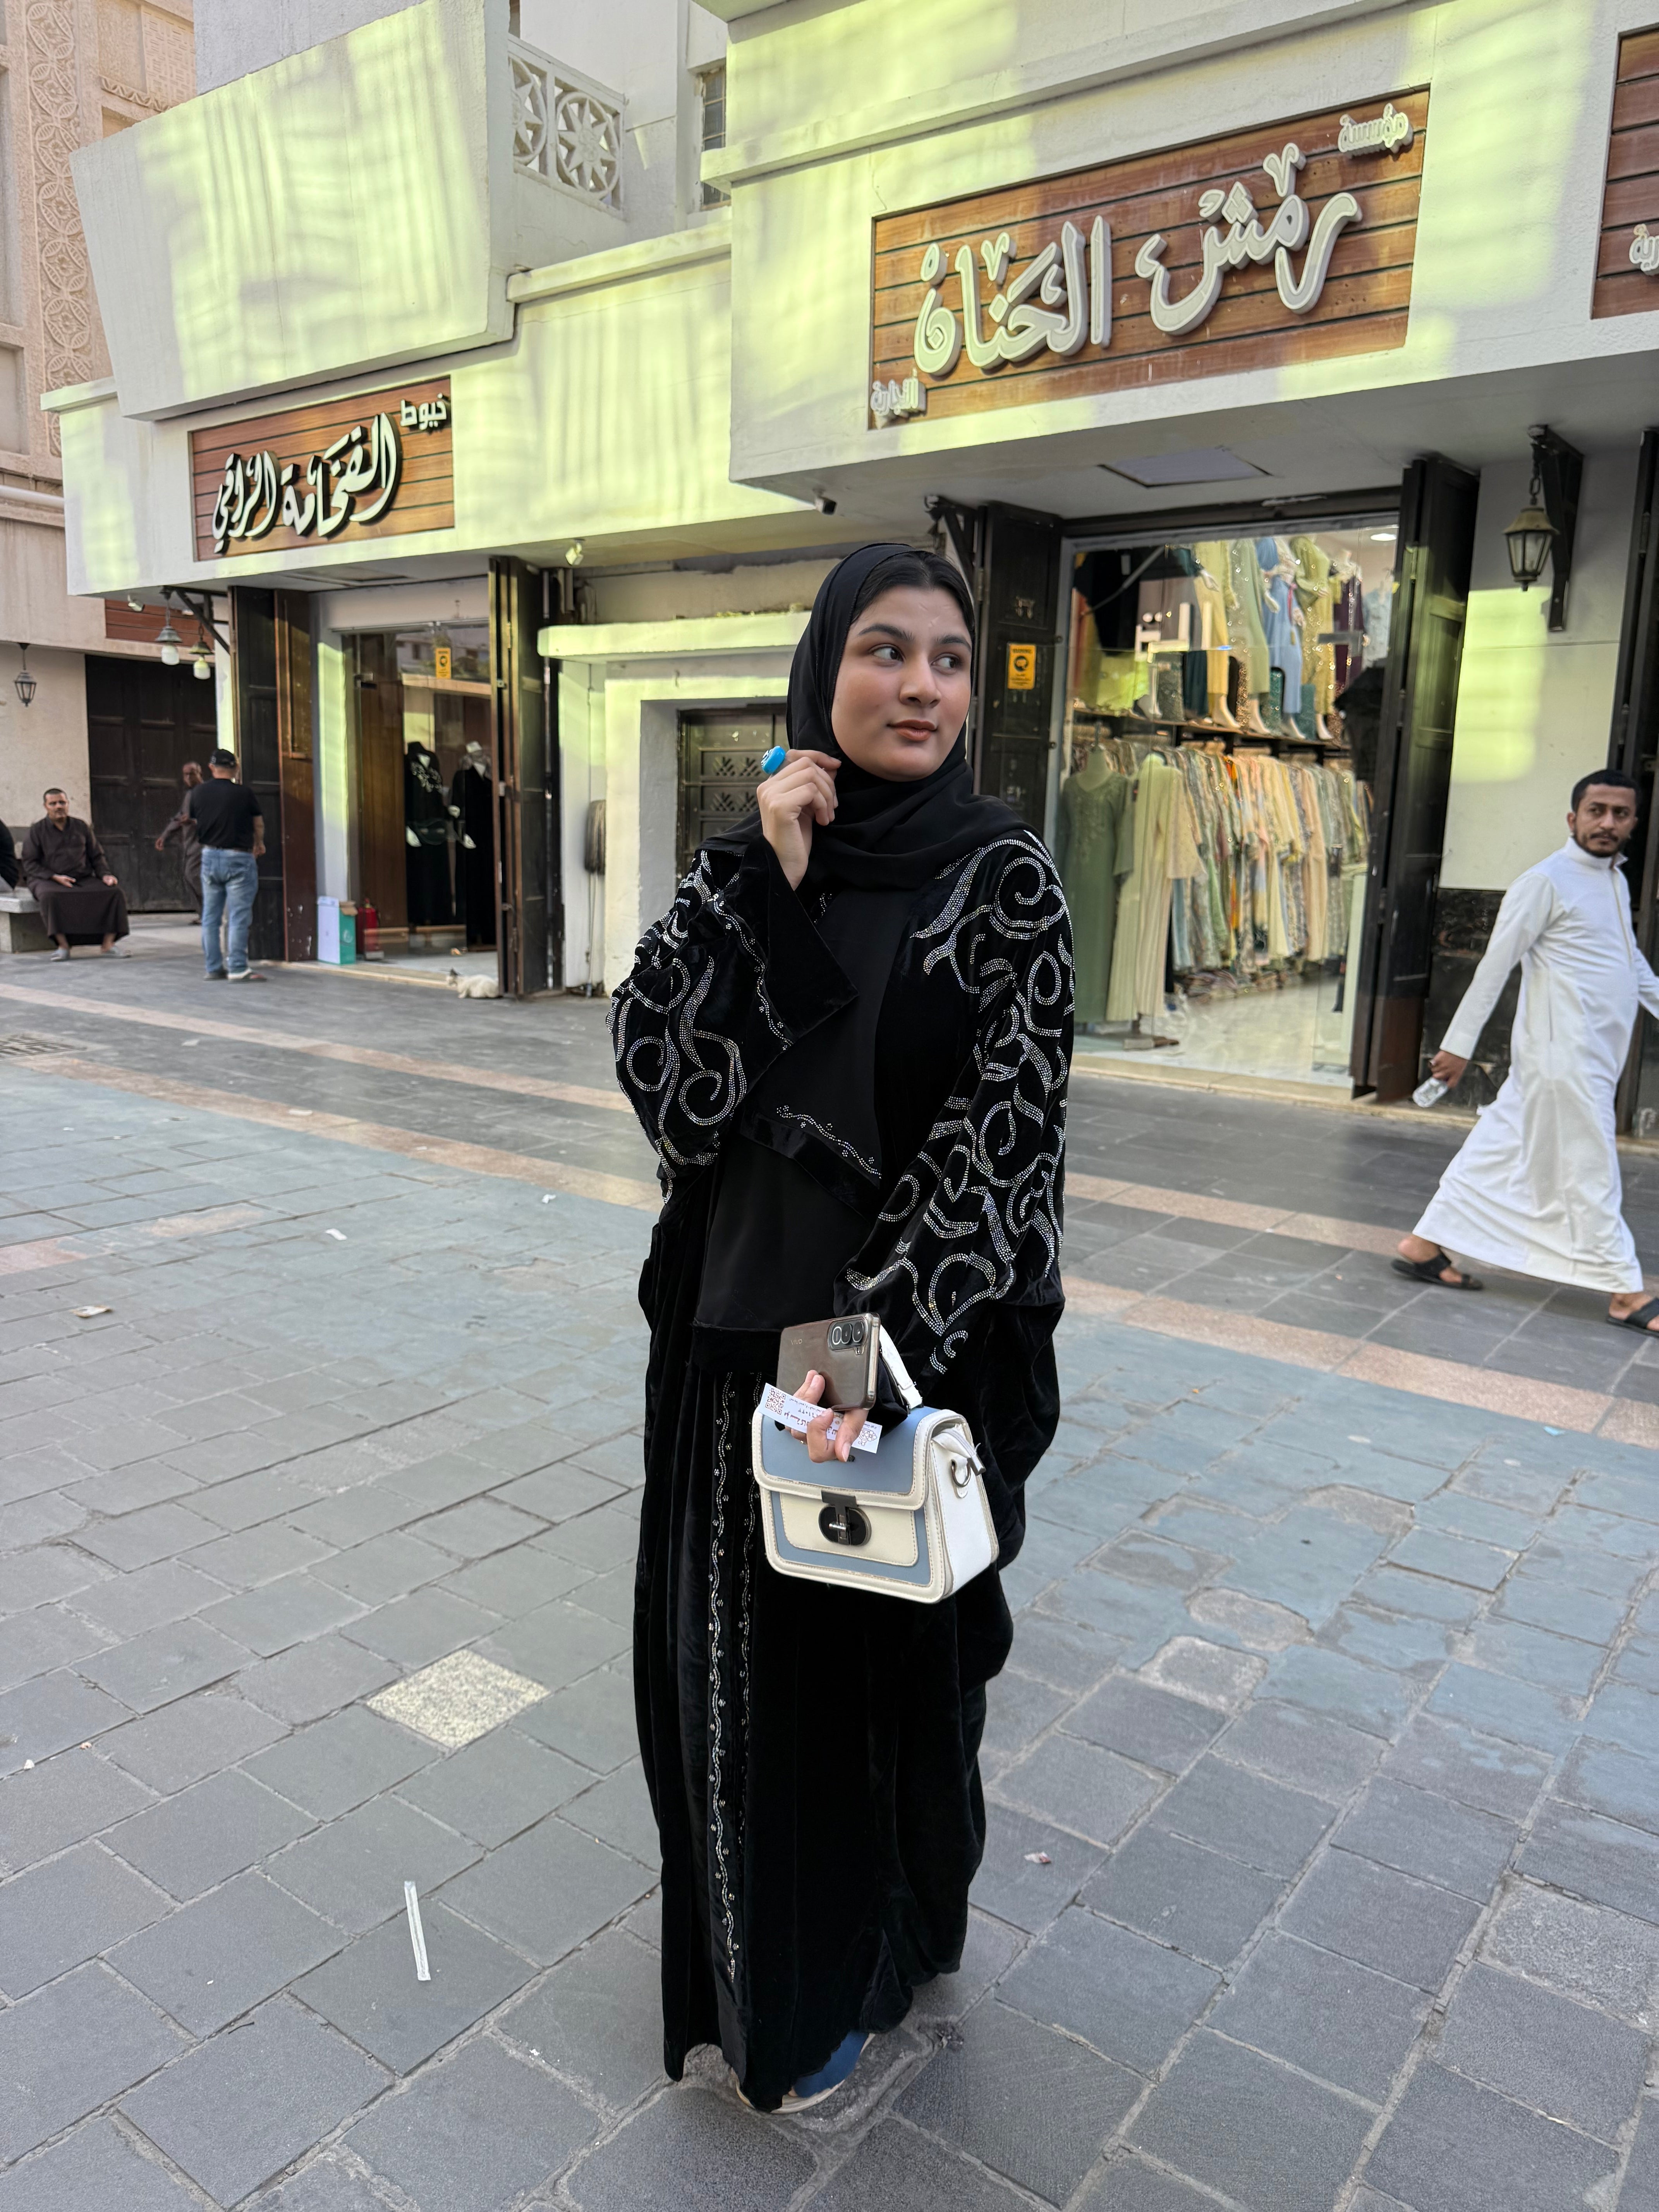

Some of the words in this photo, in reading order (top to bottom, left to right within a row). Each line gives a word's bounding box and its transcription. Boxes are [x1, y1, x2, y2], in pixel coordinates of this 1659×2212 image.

[1338, 103, 1409, 153] مؤسسة
[914, 215, 1105, 373] الحنان
[400, 392, 447, 430] خيوط
[212, 450, 276, 553] الراقي
[281, 412, 397, 537] الفخامة
